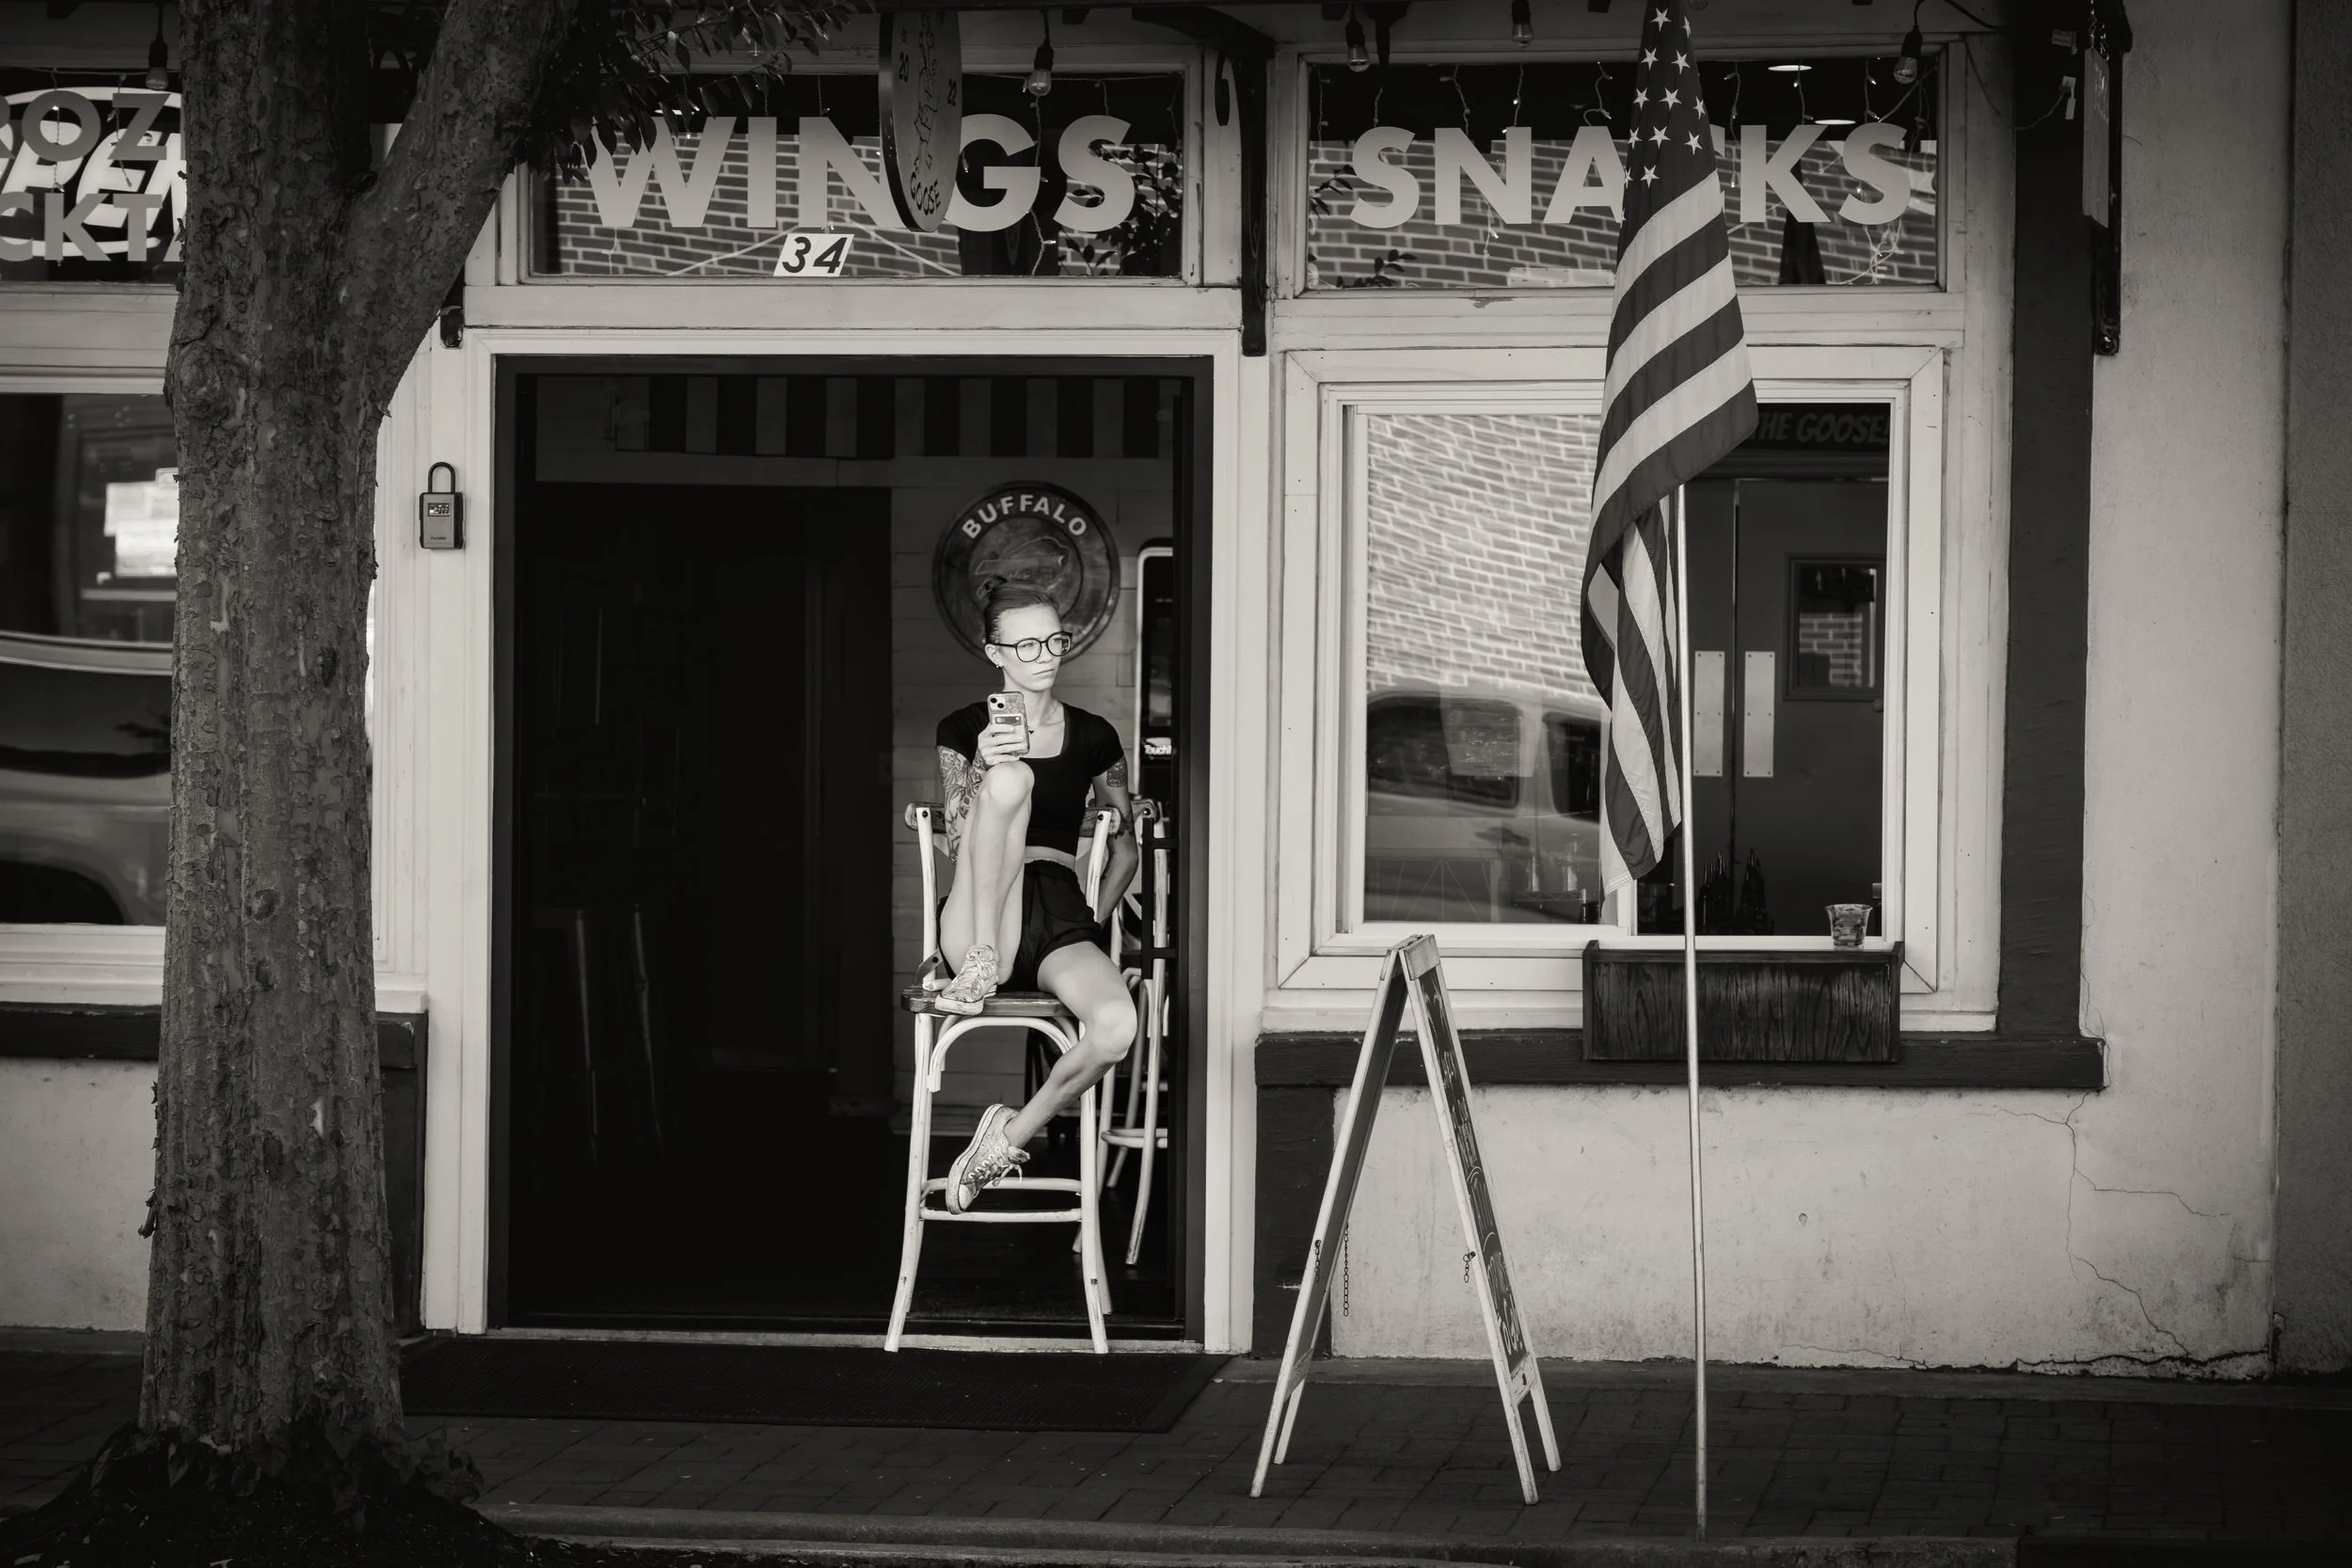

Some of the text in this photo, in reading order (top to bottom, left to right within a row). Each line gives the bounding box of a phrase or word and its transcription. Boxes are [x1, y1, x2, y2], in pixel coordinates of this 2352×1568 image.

[898, 52, 909, 82] 20
[0, 91, 185, 161] OZ
[583, 114, 1136, 232] WINGS
[910, 172, 942, 214] GOOSE
[1349, 123, 1911, 229] SNAKS
[0, 192, 183, 262] CKT
[781, 235, 848, 275] 34
[961, 495, 1088, 539] BUFFALO
